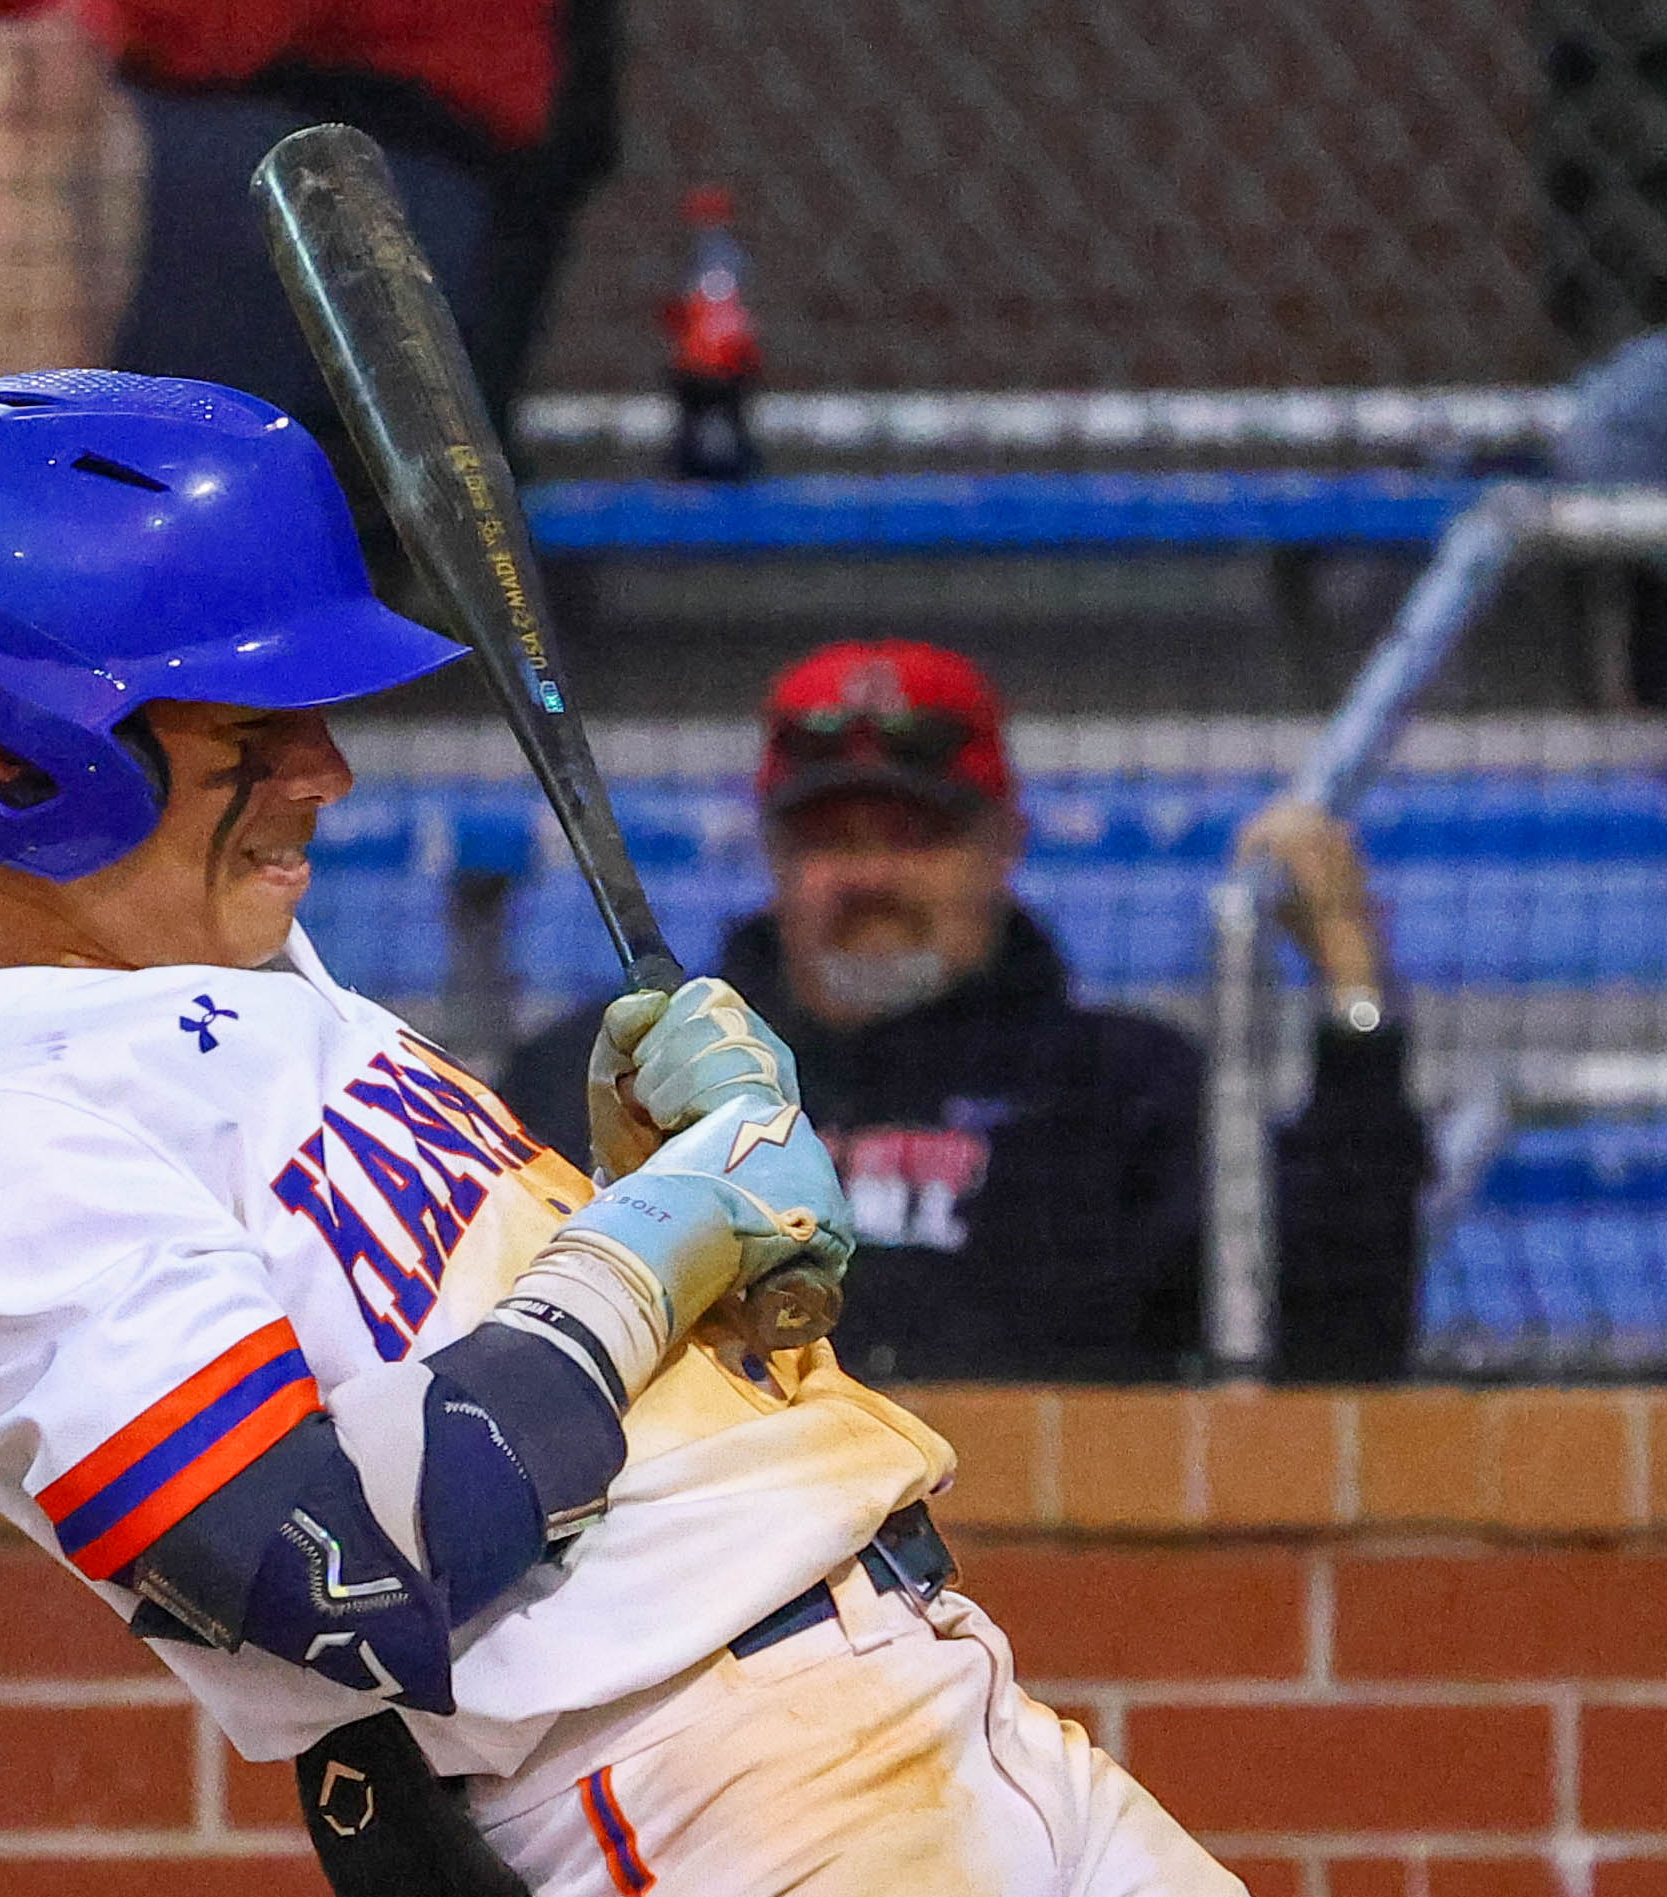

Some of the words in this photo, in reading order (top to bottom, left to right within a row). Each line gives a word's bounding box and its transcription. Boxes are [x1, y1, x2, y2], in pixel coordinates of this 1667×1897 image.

[489, 550, 527, 607] MADE
[270, 1029, 547, 1362] HANA
[616, 1196, 671, 1222] BOLT
